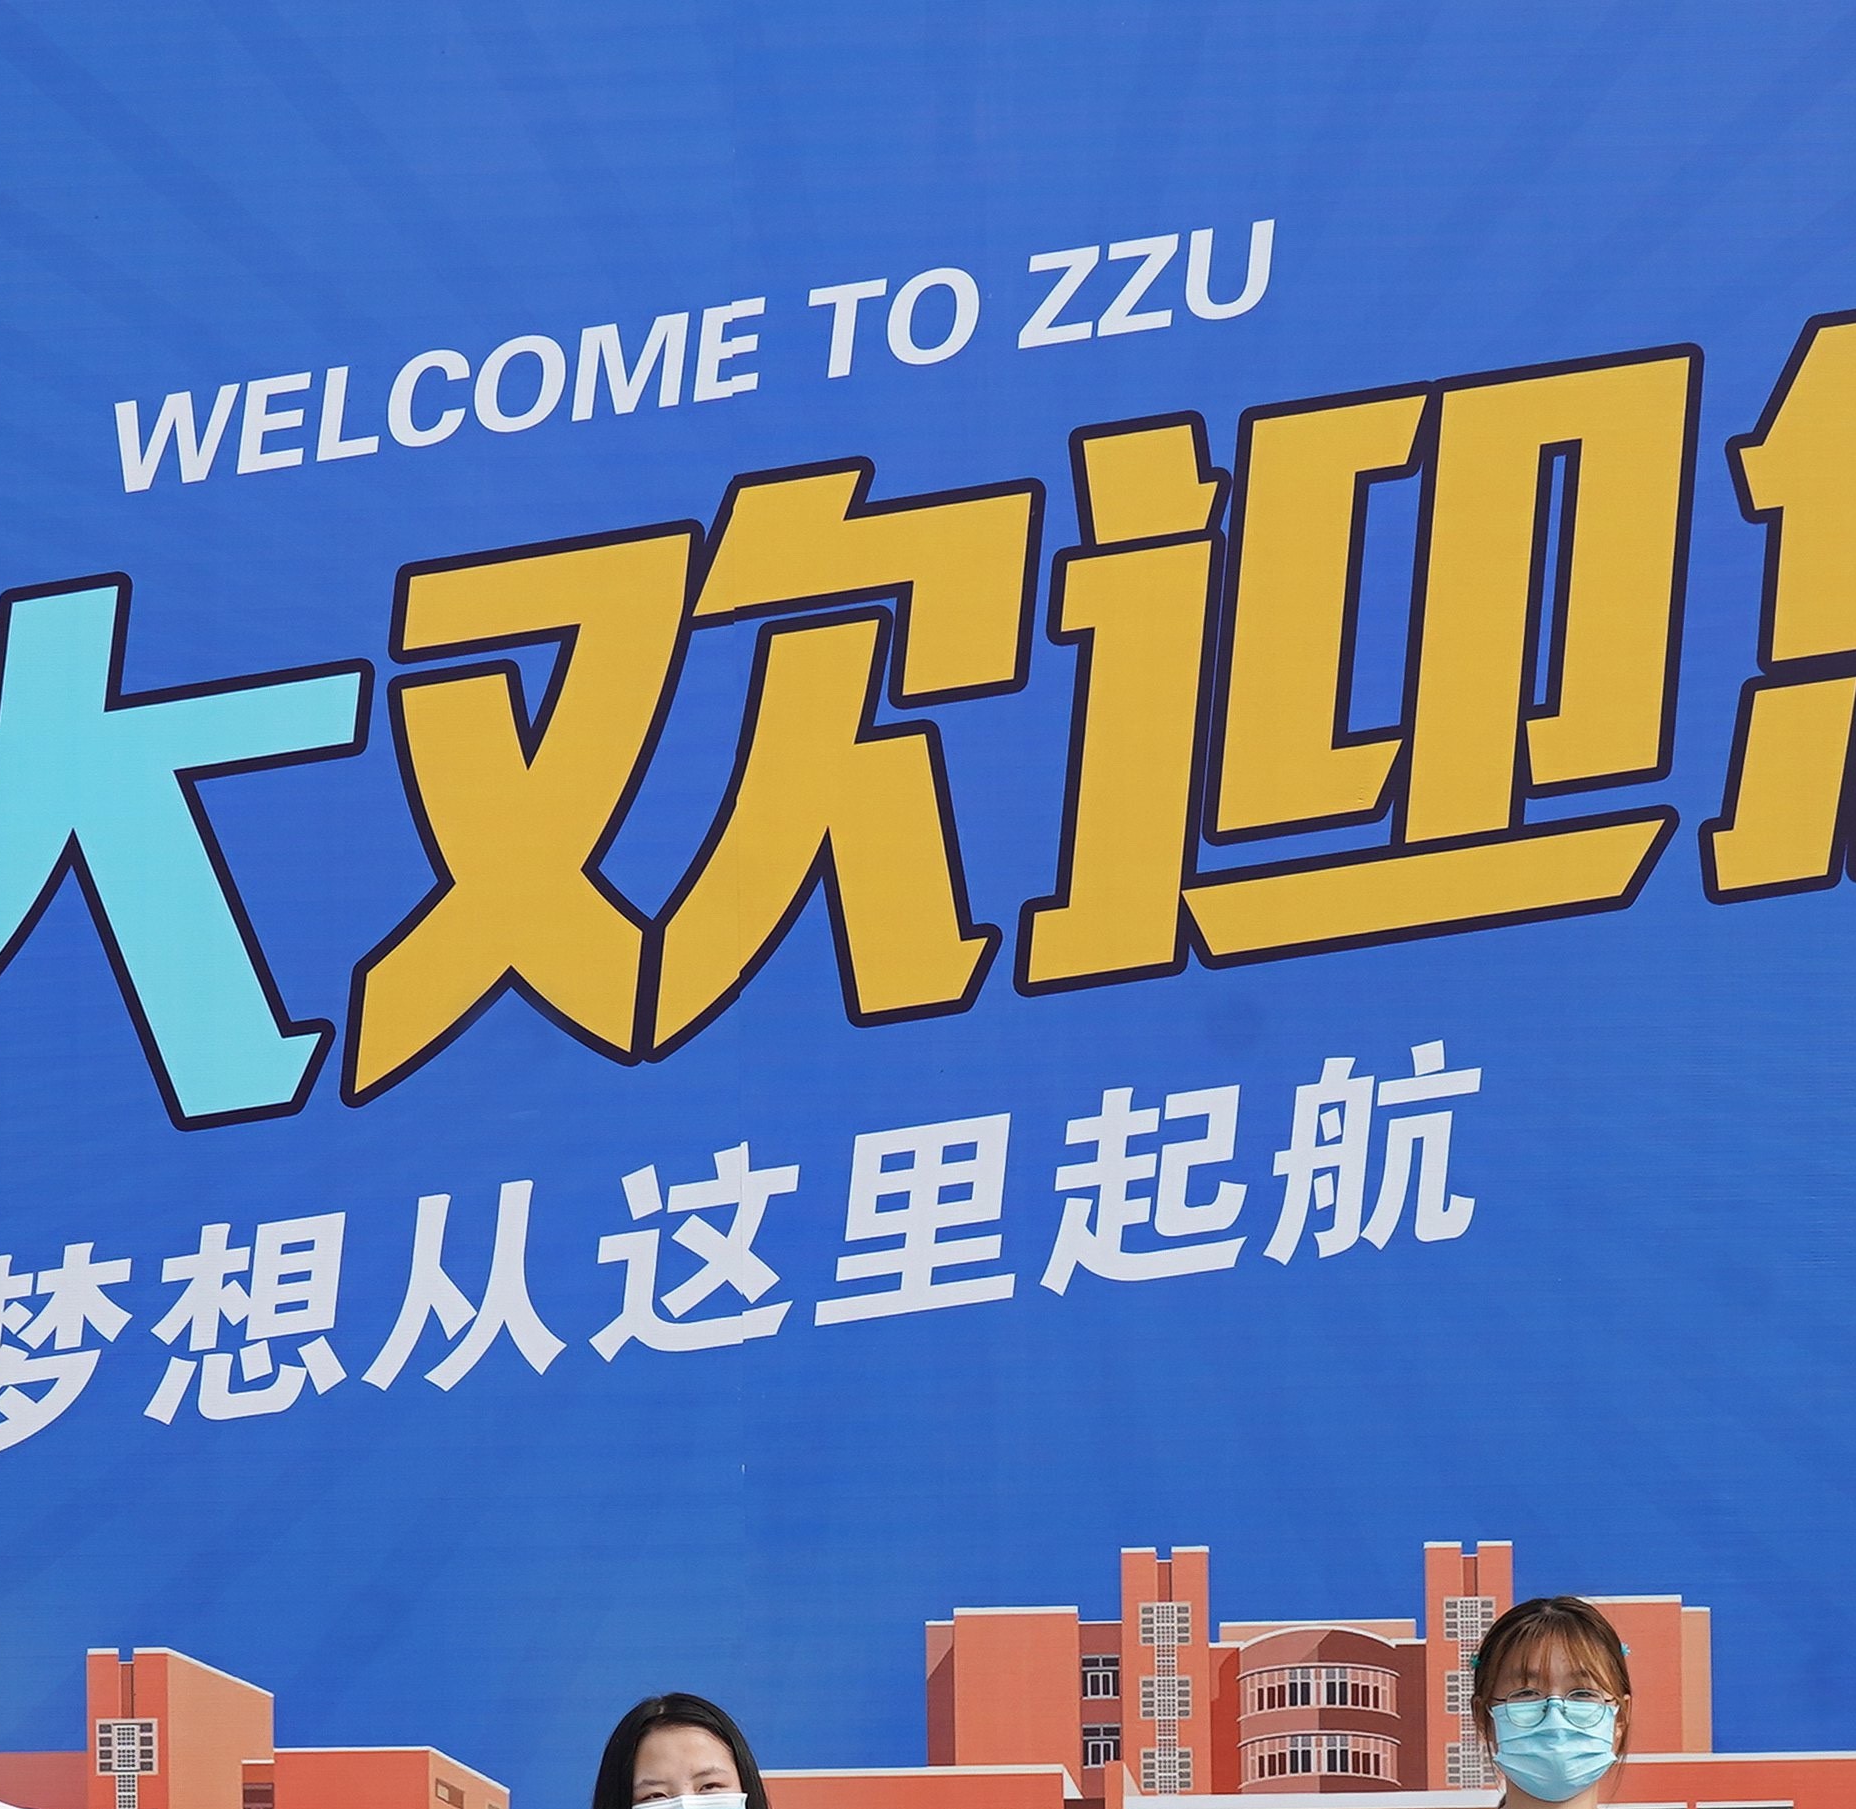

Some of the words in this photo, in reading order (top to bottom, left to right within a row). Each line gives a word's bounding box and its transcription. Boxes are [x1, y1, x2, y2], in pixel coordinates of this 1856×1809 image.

[113, 296, 766, 493] WELCOME
[808, 266, 979, 379] TO
[1018, 219, 1276, 350] ZZU
